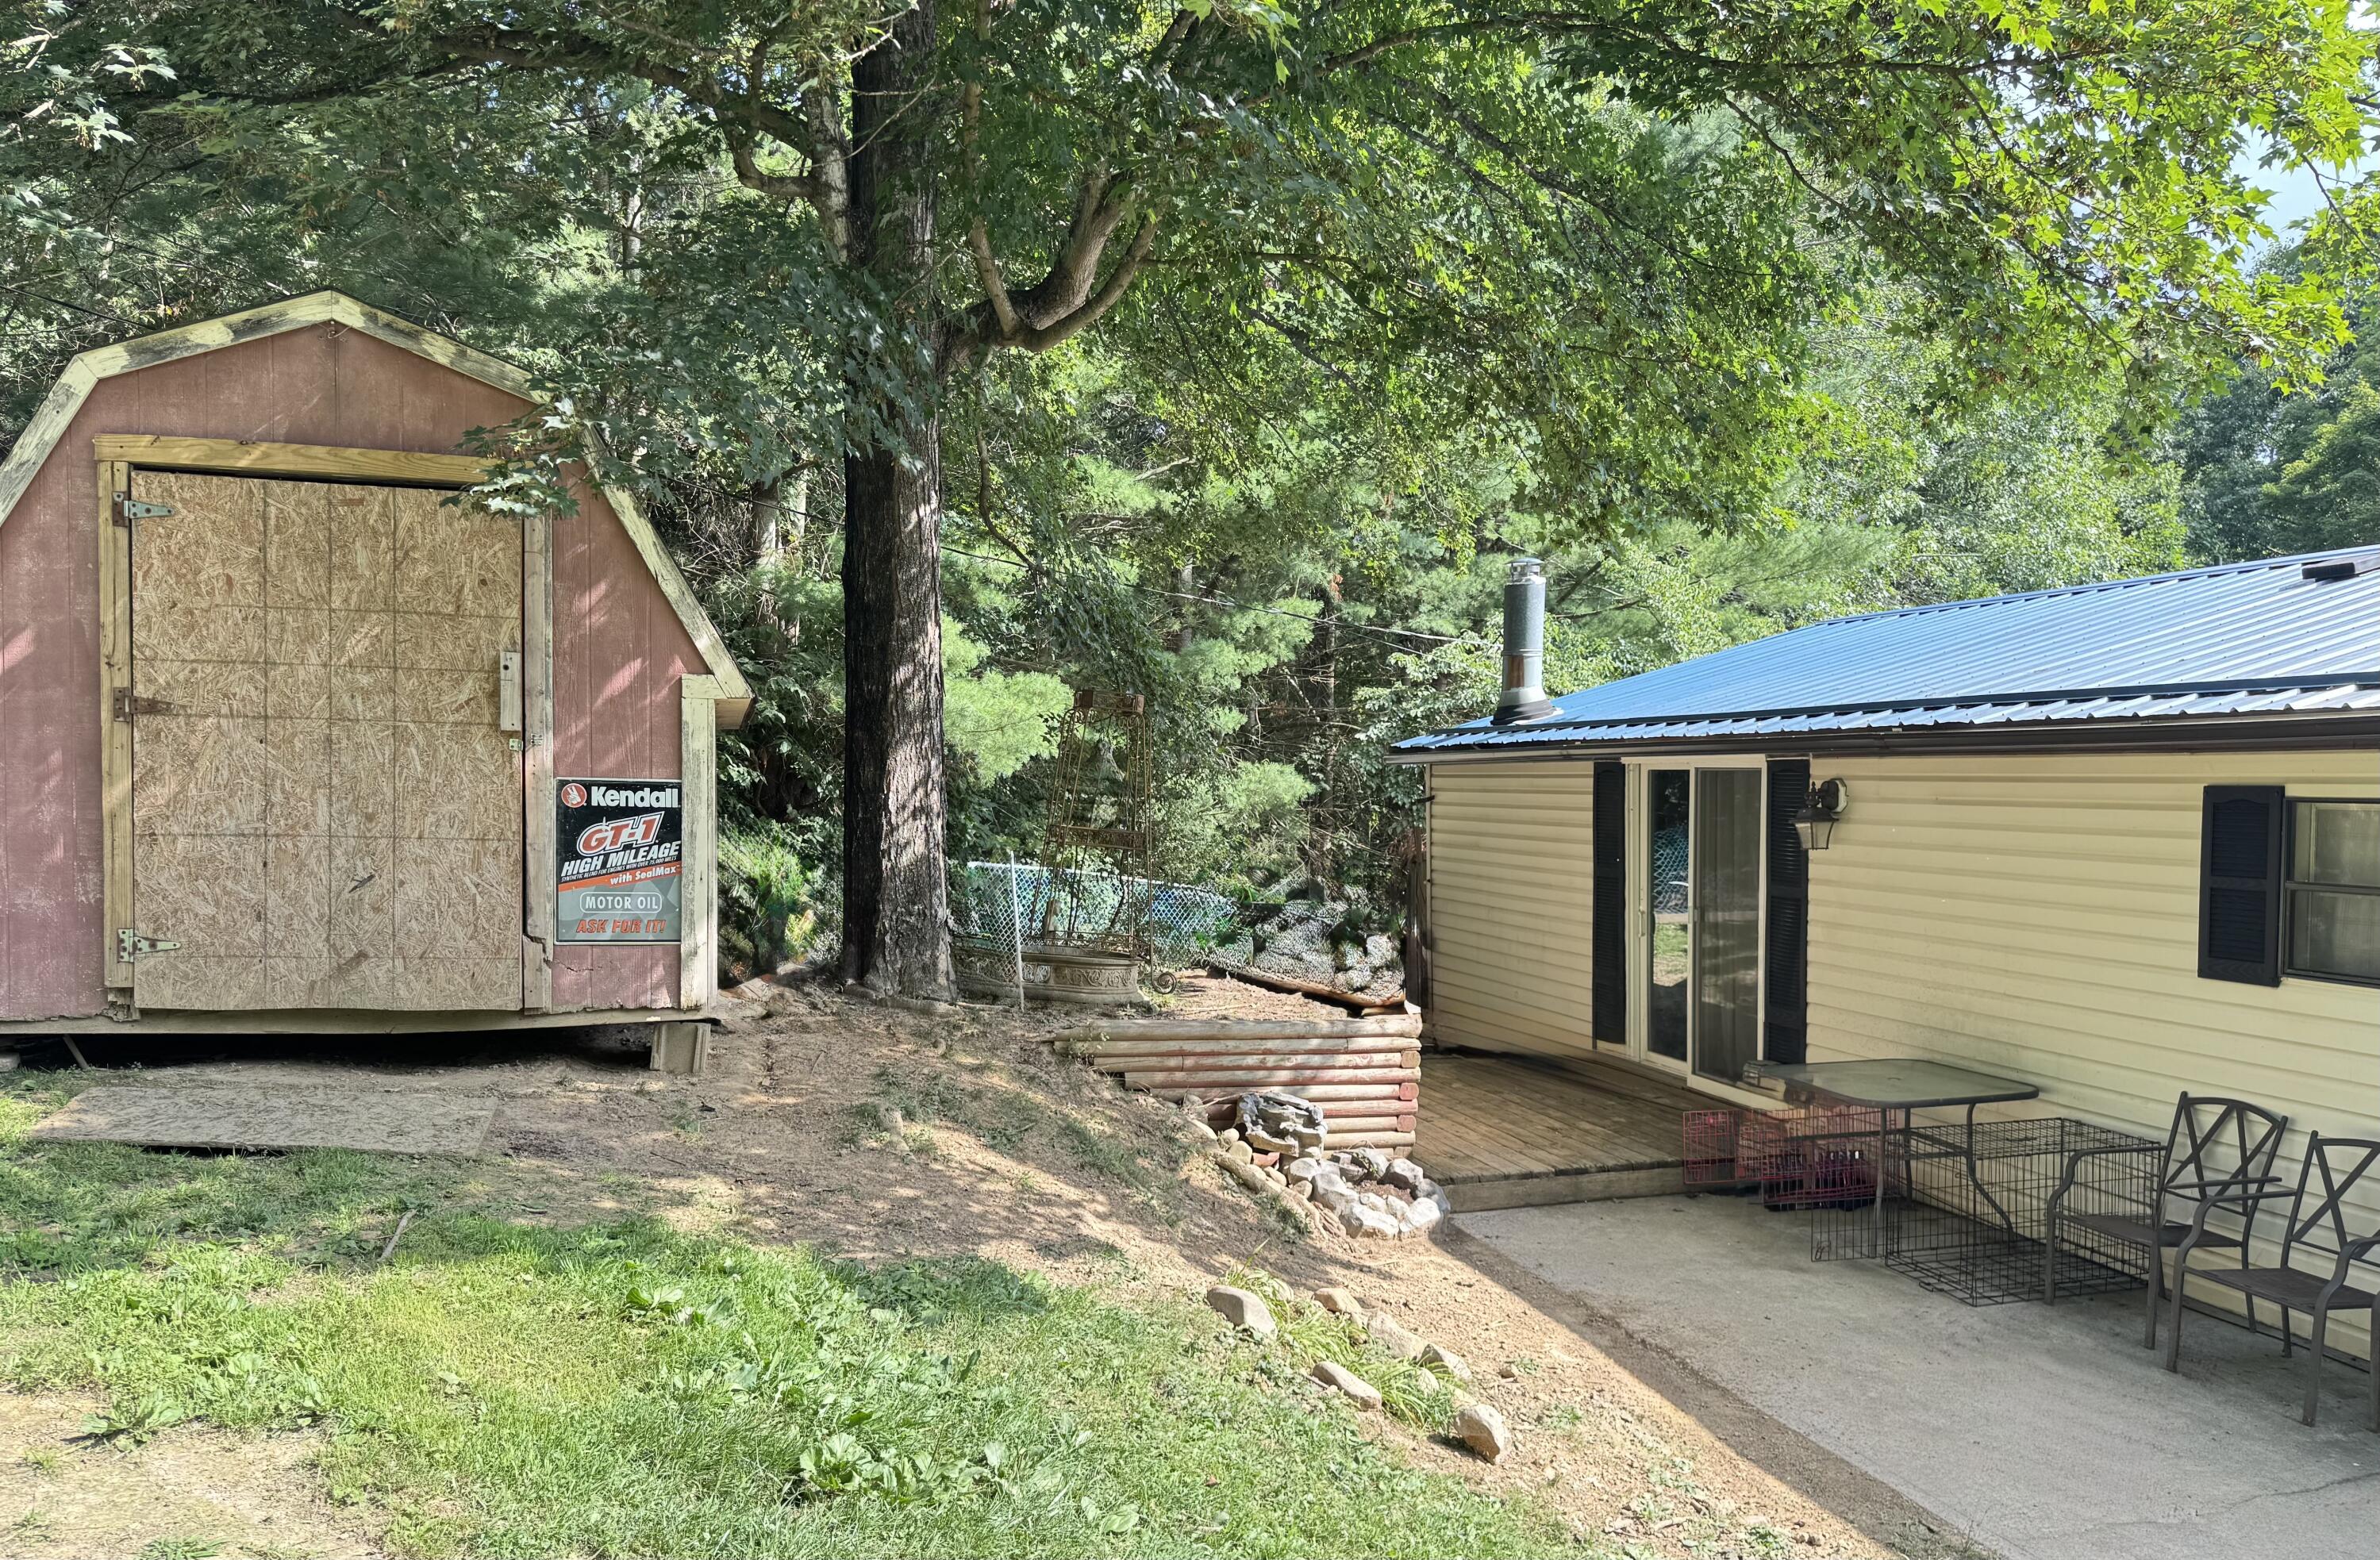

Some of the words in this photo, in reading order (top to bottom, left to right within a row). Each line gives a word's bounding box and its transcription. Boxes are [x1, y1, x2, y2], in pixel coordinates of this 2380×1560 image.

[591, 786, 679, 809] Kendall
[579, 813, 662, 855] GT-1
[561, 855, 604, 877] HIGH
[606, 840, 682, 868] MILEAGE
[610, 872, 632, 885] with
[635, 865, 677, 881] SealMax
[585, 896, 632, 909] MOTOR
[637, 896, 659, 909] OIL
[575, 919, 609, 933] ASK
[611, 919, 642, 933] FOR
[644, 919, 667, 933] IT!
